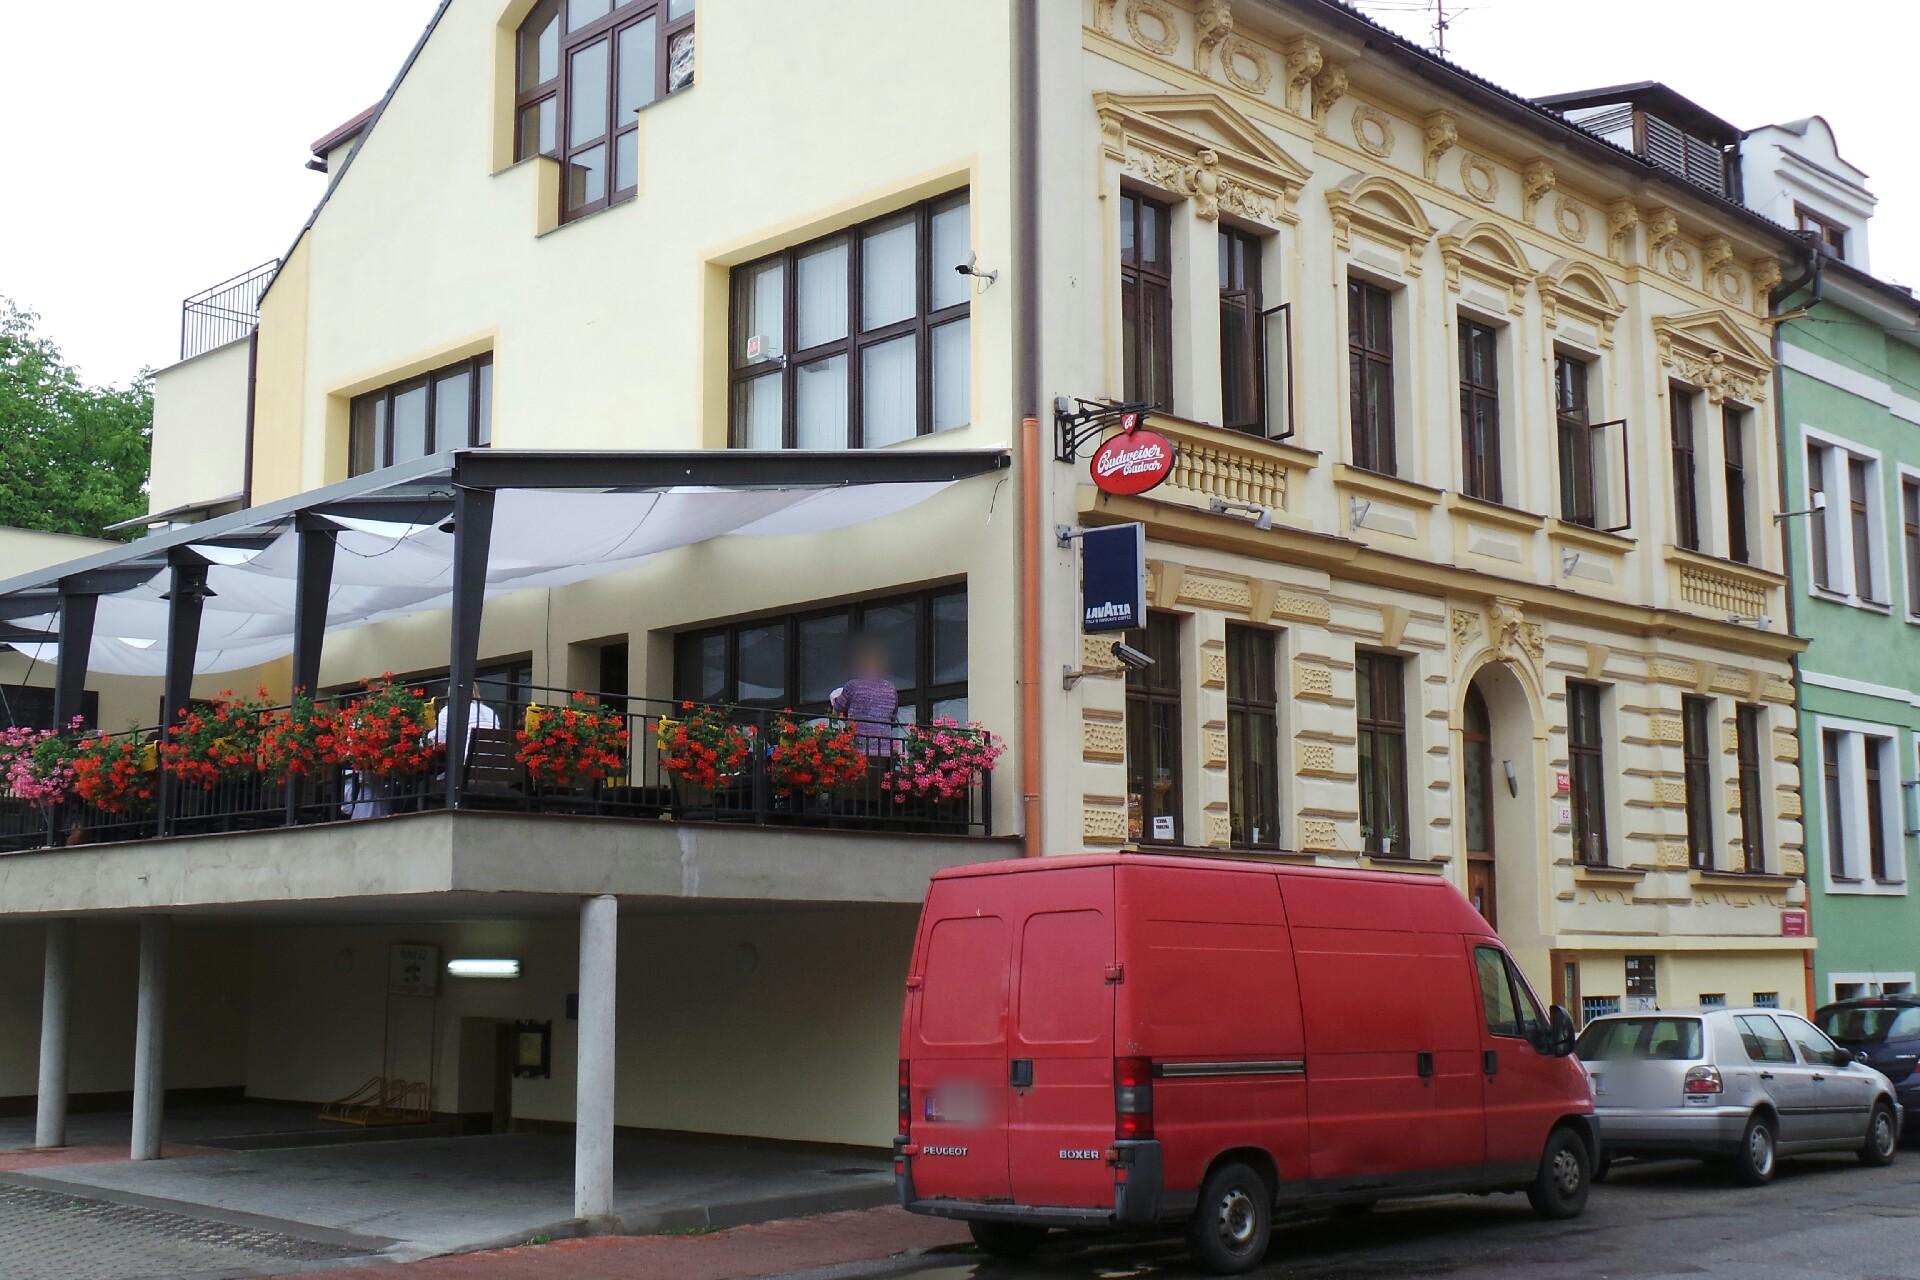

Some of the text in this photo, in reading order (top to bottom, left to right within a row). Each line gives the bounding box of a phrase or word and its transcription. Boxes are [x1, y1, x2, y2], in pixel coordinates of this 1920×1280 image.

[1098, 444, 1164, 475] Budweiser
[1123, 460, 1162, 476] Budvar
[1086, 602, 1131, 619] LAVAZZA
[923, 1146, 968, 1156] PEUGEOT
[1059, 1149, 1100, 1159] BOXER
